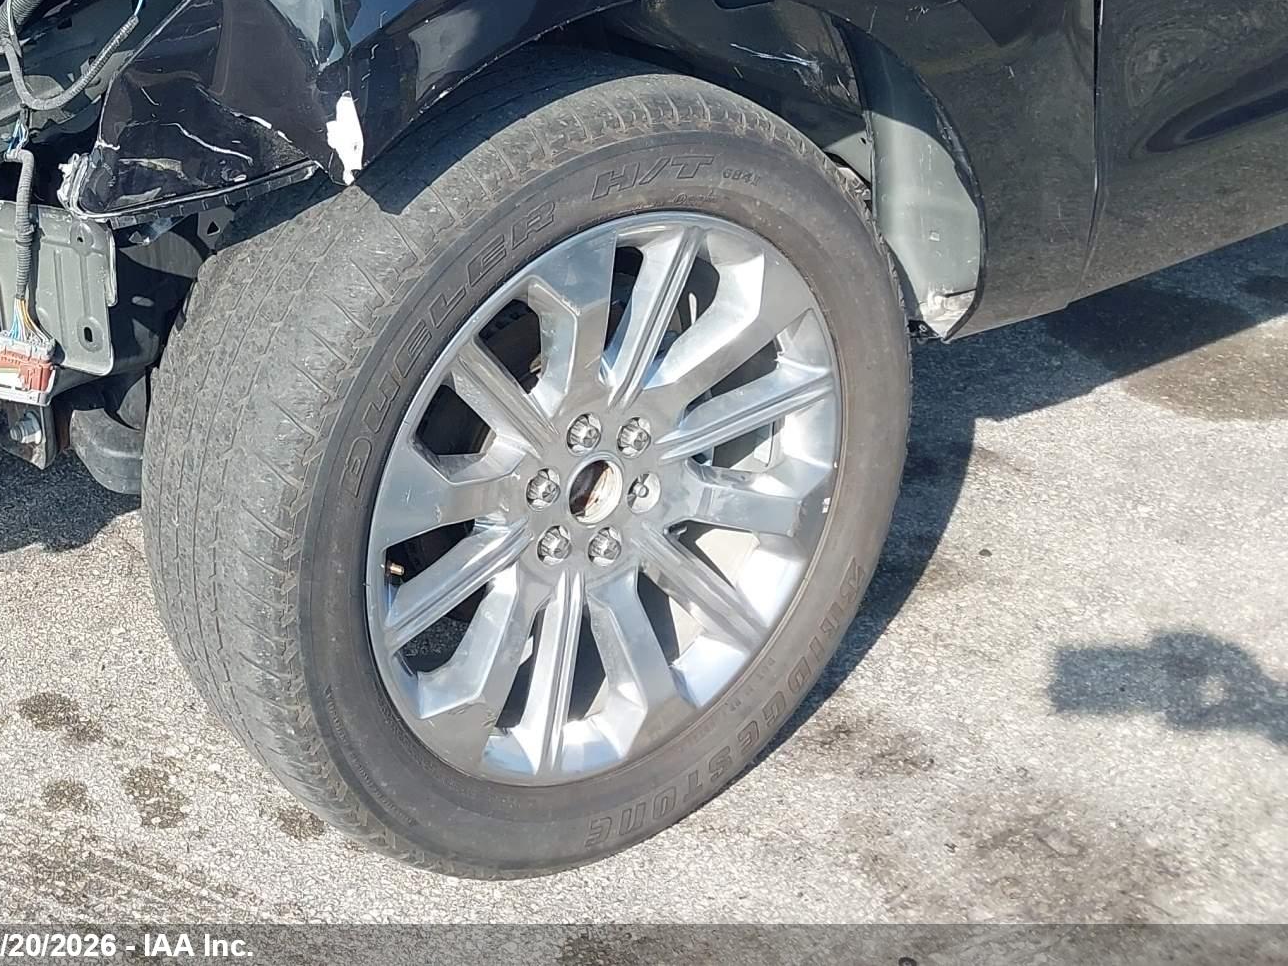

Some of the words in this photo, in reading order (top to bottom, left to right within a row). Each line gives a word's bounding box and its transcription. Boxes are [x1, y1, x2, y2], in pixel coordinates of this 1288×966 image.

[340, 198, 557, 499] DUELER
[590, 155, 714, 199] H/T
[586, 556, 865, 848] BRIDGESTONE
